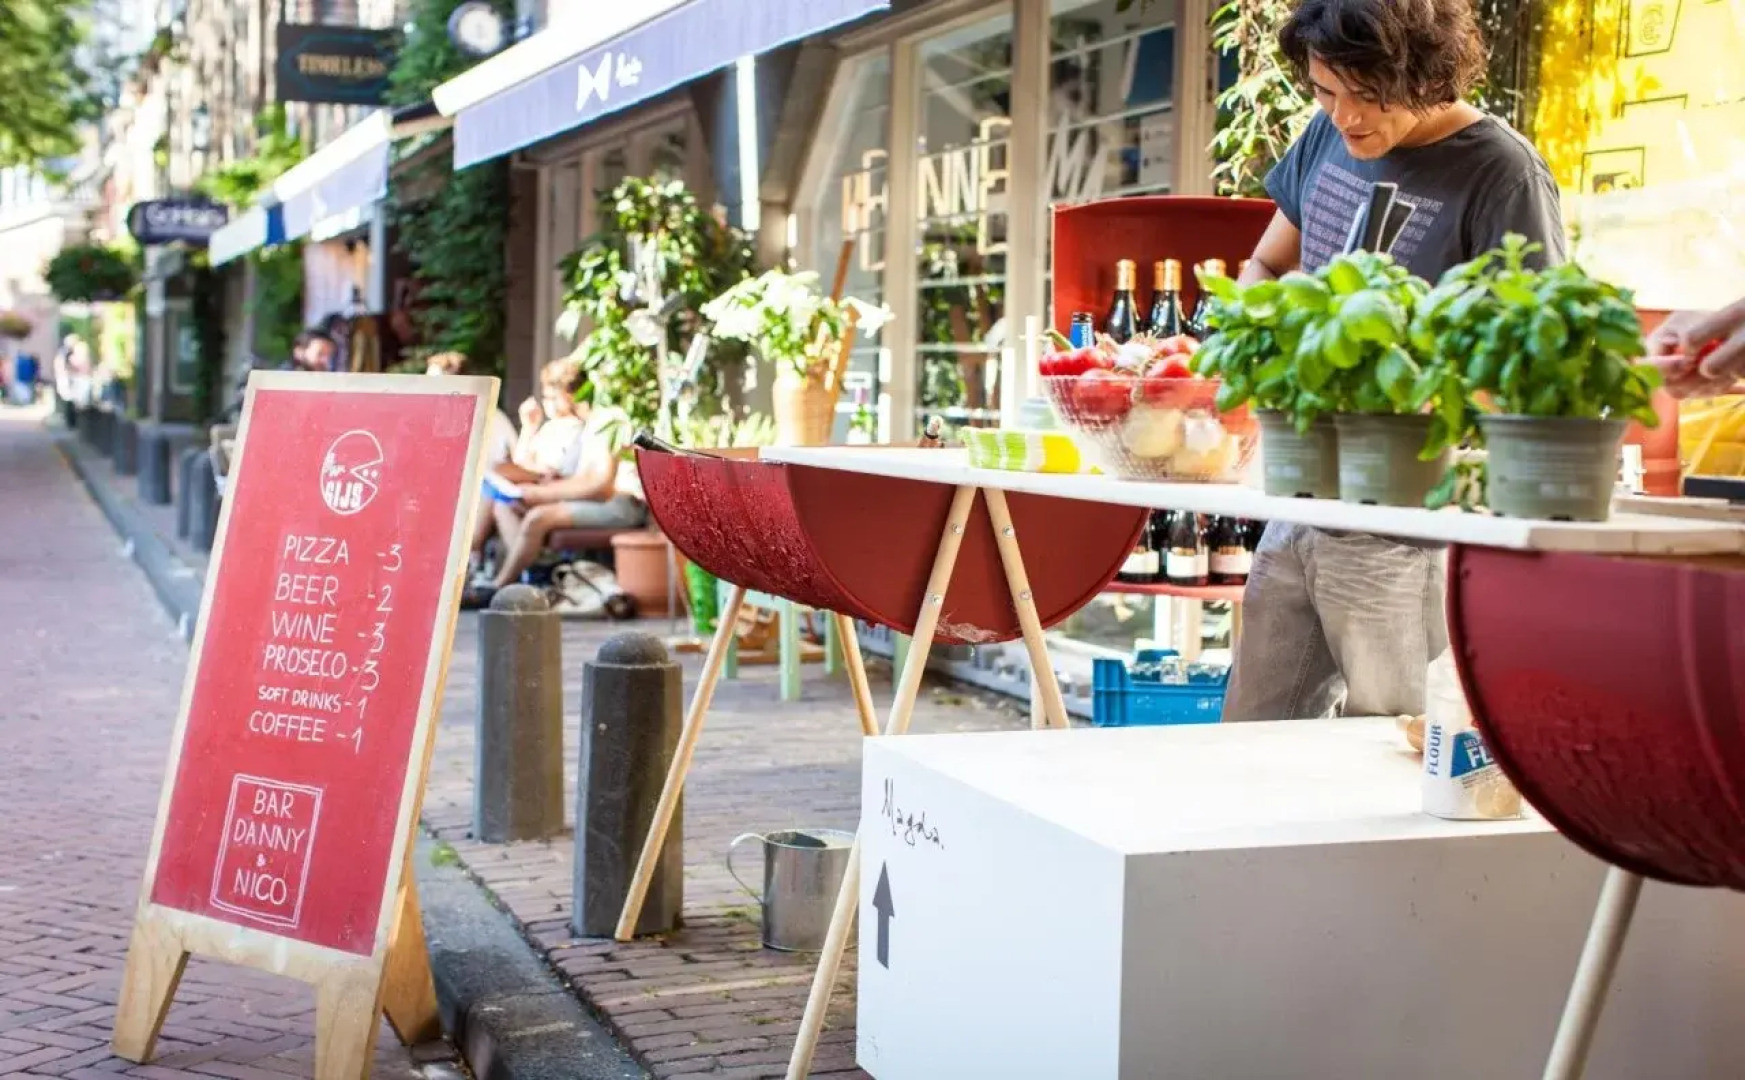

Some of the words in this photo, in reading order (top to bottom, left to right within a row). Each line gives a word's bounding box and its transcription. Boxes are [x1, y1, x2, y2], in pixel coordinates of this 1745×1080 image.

[283, 534, 350, 565] PIZZA
[274, 572, 340, 606] BEER
[271, 610, 338, 643] WINE
[262, 644, 348, 679] PROSECO
[257, 685, 290, 704] SOFT
[291, 688, 342, 714] DRINKS
[249, 710, 327, 743] COFFEE
[1428, 723, 1442, 776] FLOUR
[253, 788, 294, 819] BAR
[233, 817, 306, 854] DANNY
[256, 852, 267, 867] &
[233, 867, 287, 905] NICO
